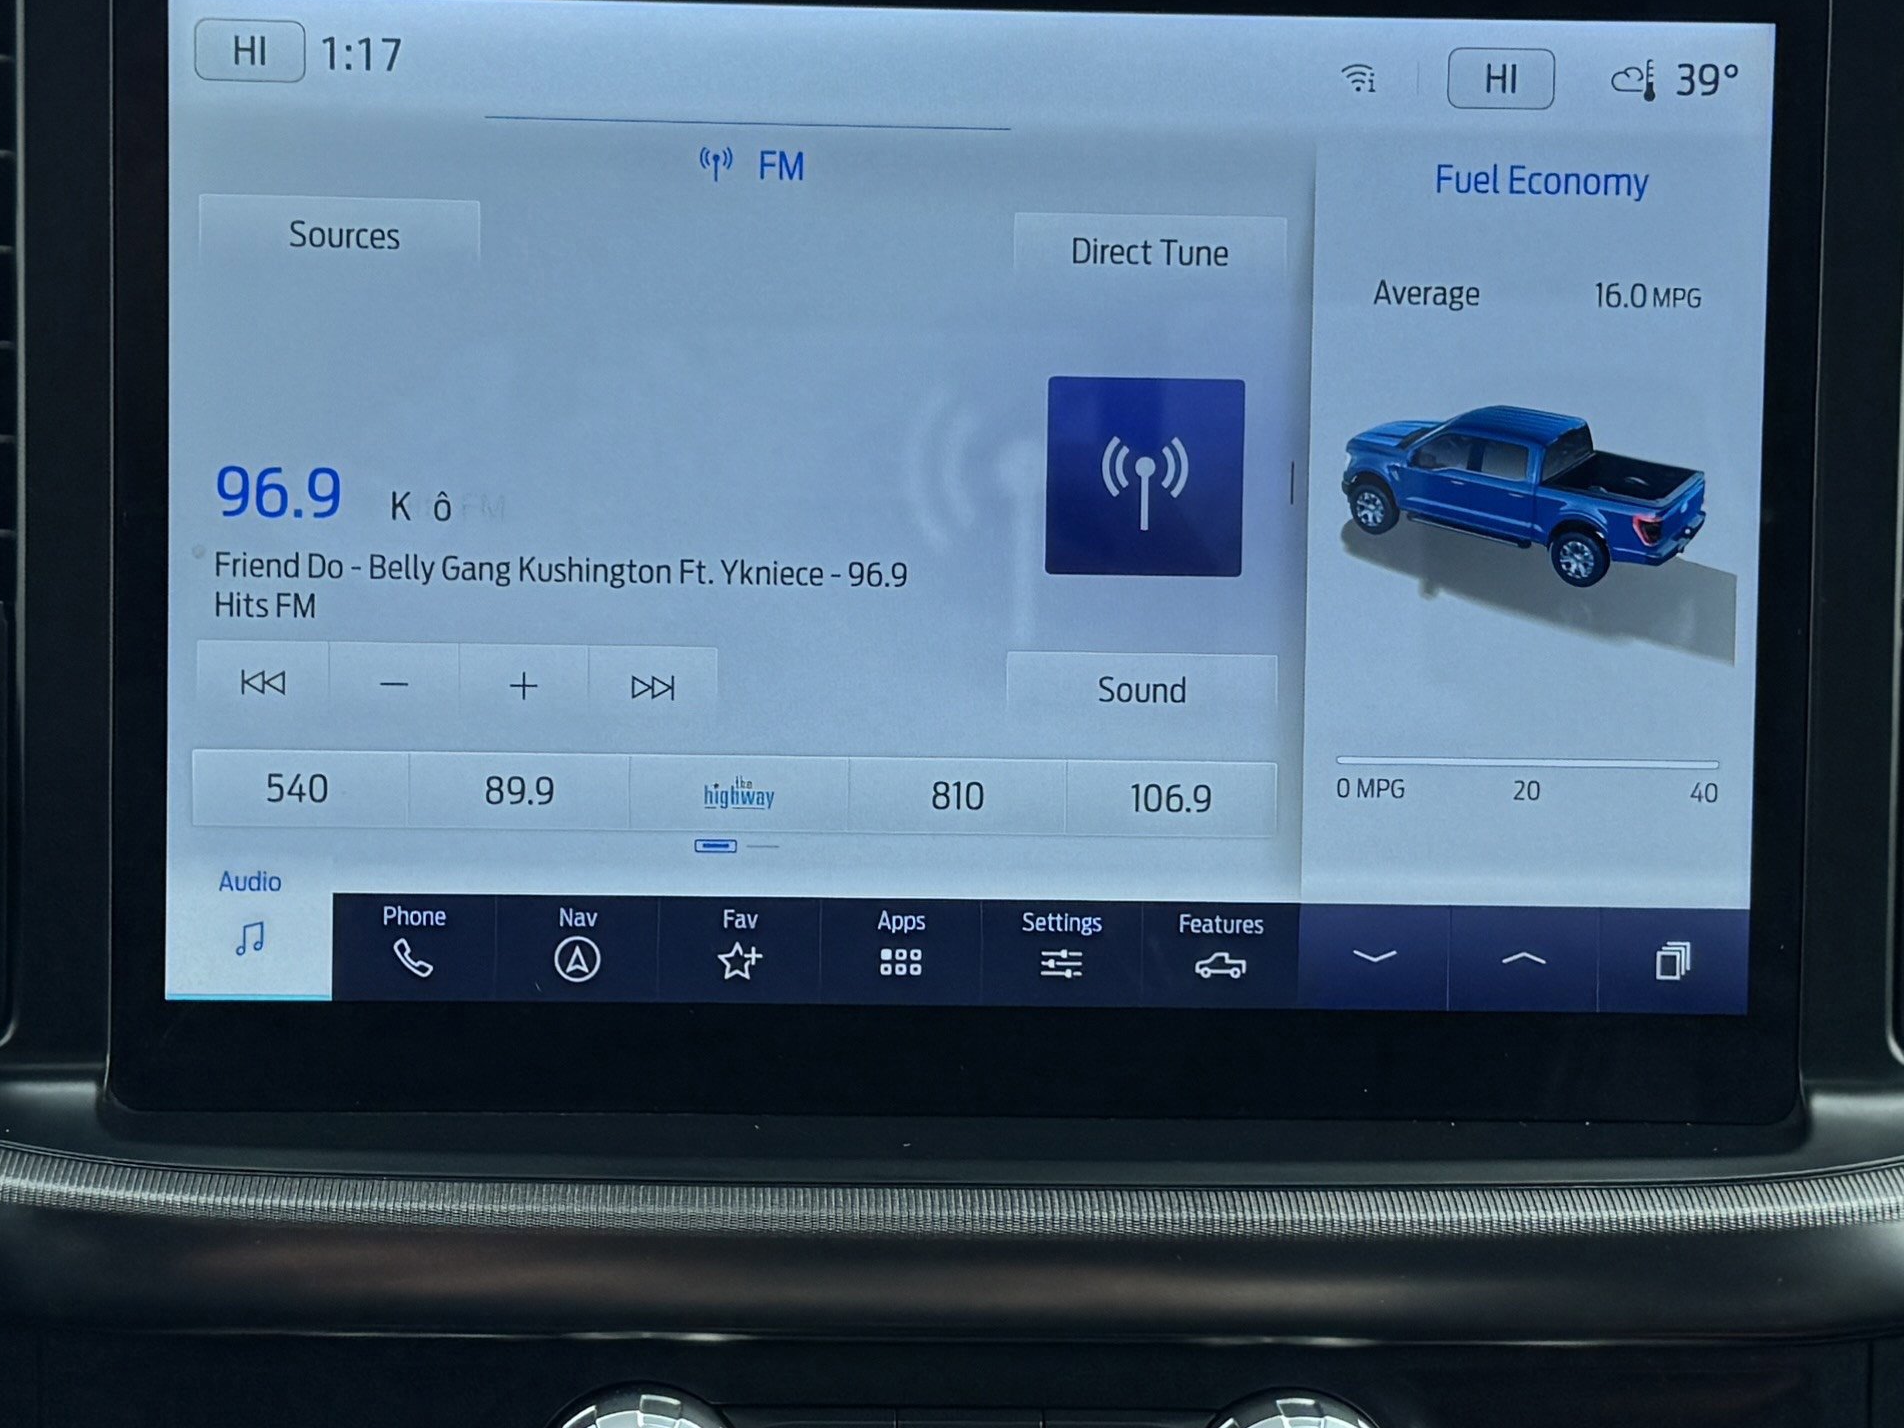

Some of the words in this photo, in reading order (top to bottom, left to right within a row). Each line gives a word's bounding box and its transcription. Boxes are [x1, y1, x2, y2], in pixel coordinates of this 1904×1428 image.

[234, 36, 266, 66] HI
[322, 36, 402, 72] 1:17
[1486, 65, 1516, 94] HI
[1677, 62, 1739, 97] 39°
[759, 152, 804, 181] FM
[1436, 164, 1497, 195] Fuel
[1509, 165, 1649, 202] Economy
[290, 220, 400, 251] Sources
[1072, 238, 1151, 267] Direct
[1160, 239, 1229, 267] Tune
[1374, 279, 1479, 312] Average
[1595, 283, 1647, 309] 16.0
[1653, 287, 1702, 309] MPG
[217, 465, 341, 519] 96.9
[392, 491, 410, 521] K
[215, 550, 299, 582] Friend
[308, 553, 343, 581] Do
[369, 555, 434, 586] Belly
[441, 557, 512, 588] Gang
[519, 556, 672, 591] Kushington
[680, 559, 716, 586] Ft.
[721, 559, 823, 589] Ykniece
[848, 562, 908, 589] 96.9
[215, 591, 269, 620] Hits
[276, 592, 316, 620] FM
[1099, 676, 1186, 705] Sound
[266, 775, 327, 805] 540
[485, 777, 554, 807] 89.9
[704, 783, 775, 809] highway
[931, 782, 985, 812] 810
[1131, 783, 1212, 813] 106.9
[1336, 779, 1350, 800] 0
[1357, 780, 1406, 800] MPG
[1514, 781, 1541, 802] 20
[1690, 782, 1718, 804] 40
[219, 870, 282, 894] Audio
[384, 906, 446, 928] Phone
[560, 907, 597, 928] Nav
[723, 910, 758, 931] Fav
[878, 911, 926, 936] Apps
[1022, 912, 1102, 938] Settings
[1179, 914, 1264, 935] Features
